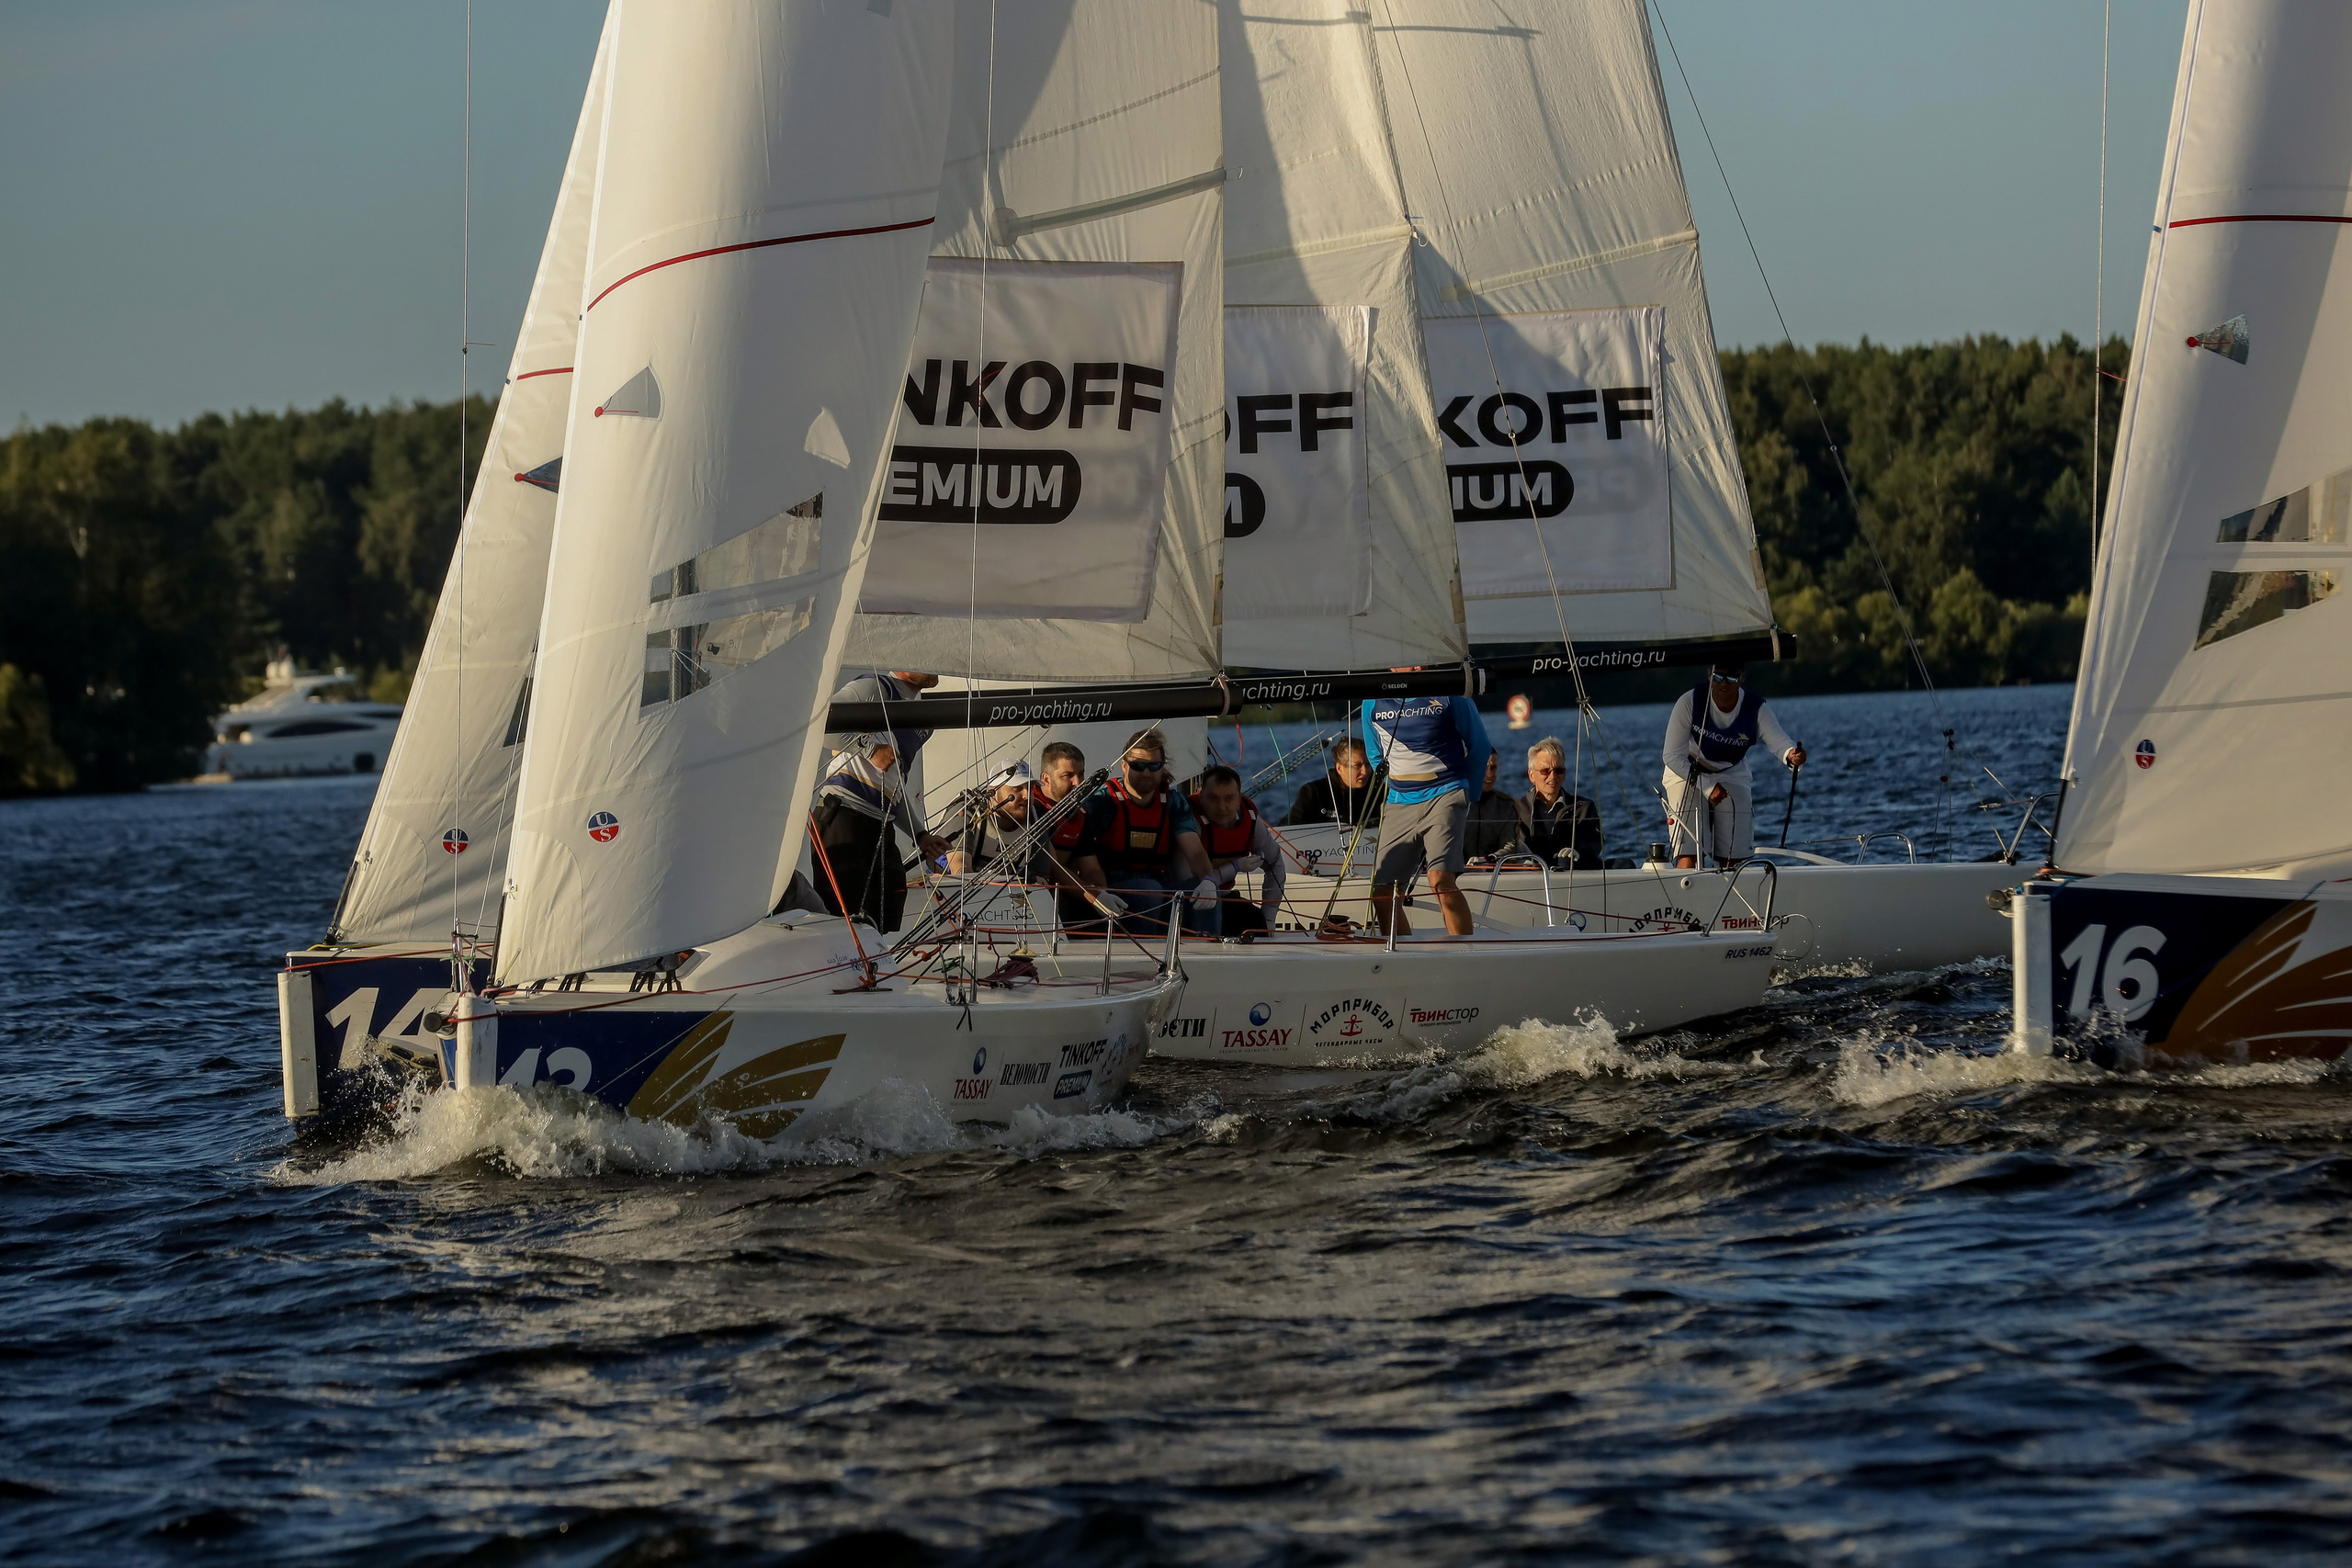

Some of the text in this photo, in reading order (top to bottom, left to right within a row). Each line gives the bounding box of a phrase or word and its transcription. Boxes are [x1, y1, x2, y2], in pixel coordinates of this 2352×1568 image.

[1225, 390, 1354, 455] FF
[1532, 650, 1666, 674] pro-yachting.ru
[1242, 682, 1330, 701] chting.ru
[988, 700, 1113, 724] pro-yachting.ru
[1374, 706, 1443, 721] PROYACHTING
[1692, 724, 1748, 746] ROYACHTING
[1296, 845, 1377, 860] PROYACTIN
[1725, 946, 1773, 959] RUS 1462
[2060, 924, 2167, 1022] 16
[1309, 998, 1395, 1034] МОРПРИБОР
[1221, 1028, 1294, 1047] TASSAY
[1059, 1038, 1108, 1068] TINKOFF
[1000, 1062, 1052, 1087] ВЕДОМОСТИ
[954, 1078, 993, 1100] TASSAY
